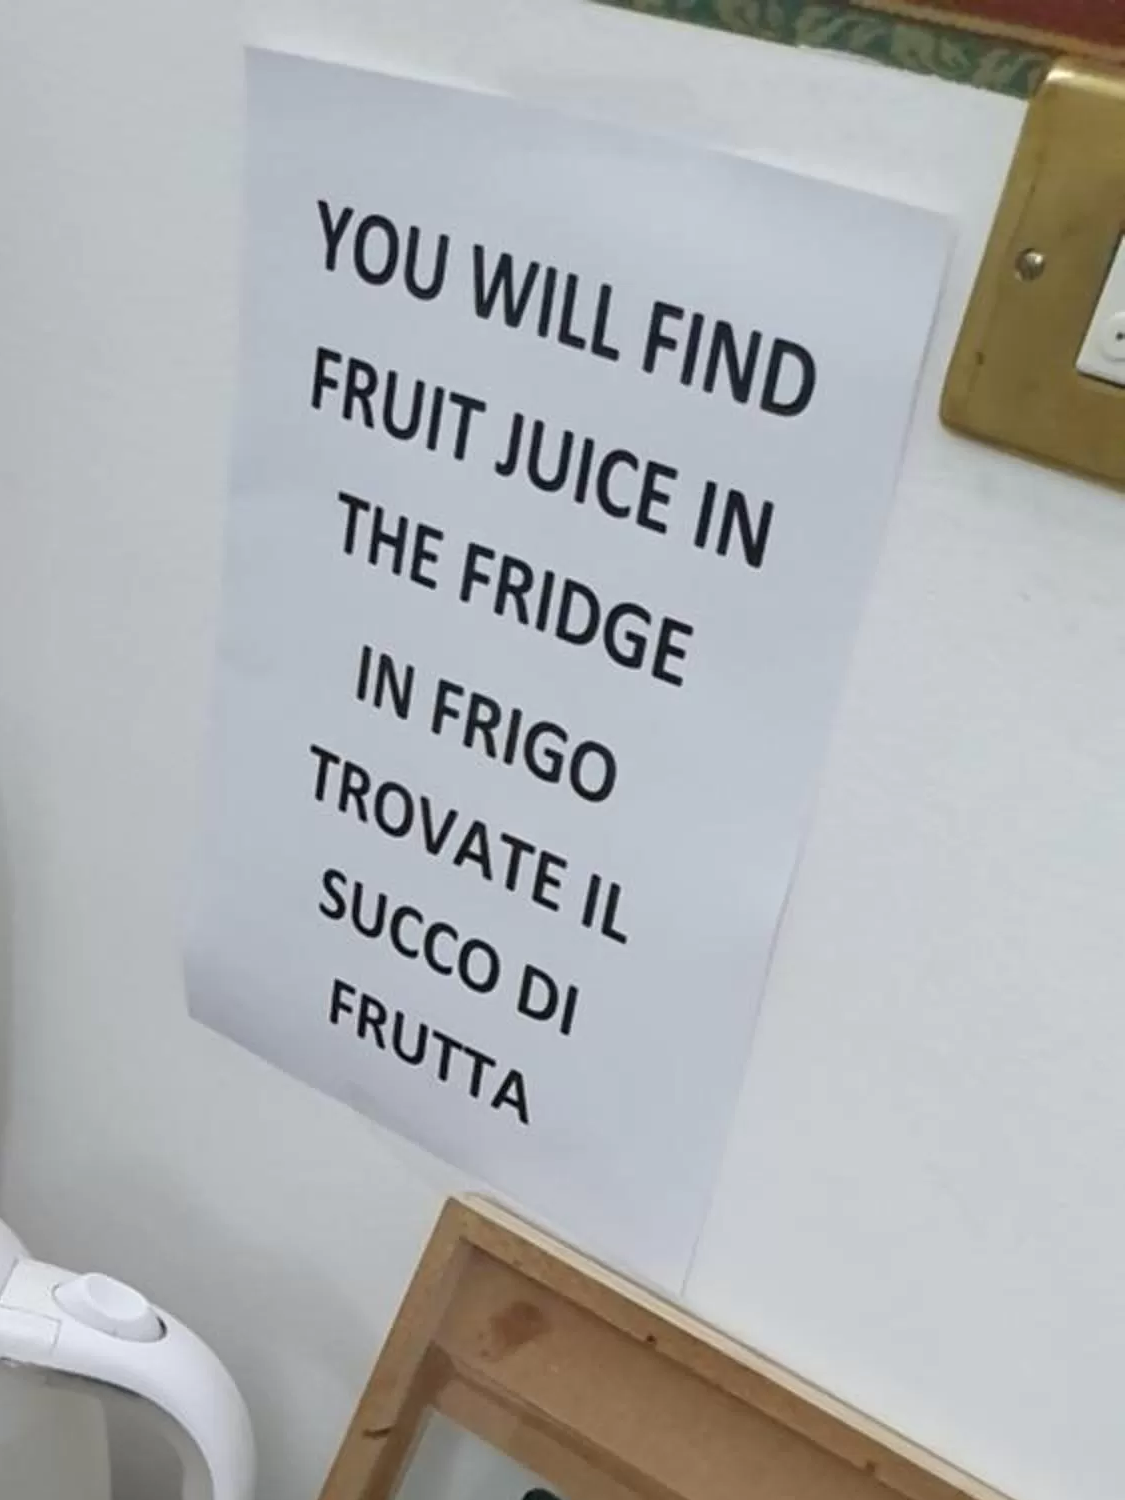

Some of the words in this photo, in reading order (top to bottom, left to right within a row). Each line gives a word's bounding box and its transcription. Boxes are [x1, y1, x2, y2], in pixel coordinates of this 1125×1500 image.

[317, 199, 450, 301] YOU
[472, 243, 620, 362] WILL
[642, 300, 817, 418] FIND
[310, 346, 487, 461] FRUIT
[494, 412, 678, 534] JUICE
[694, 480, 774, 569] IN
[337, 491, 444, 590] THE
[459, 541, 694, 687] FRIDGE
[355, 645, 415, 720] IN
[431, 679, 618, 803] FRIGO
[309, 744, 568, 912] TROVATE
[581, 873, 628, 945] IL
[318, 868, 501, 995] SUCCO
[516, 964, 579, 1036] DI
[328, 978, 530, 1125] FRUTTA
